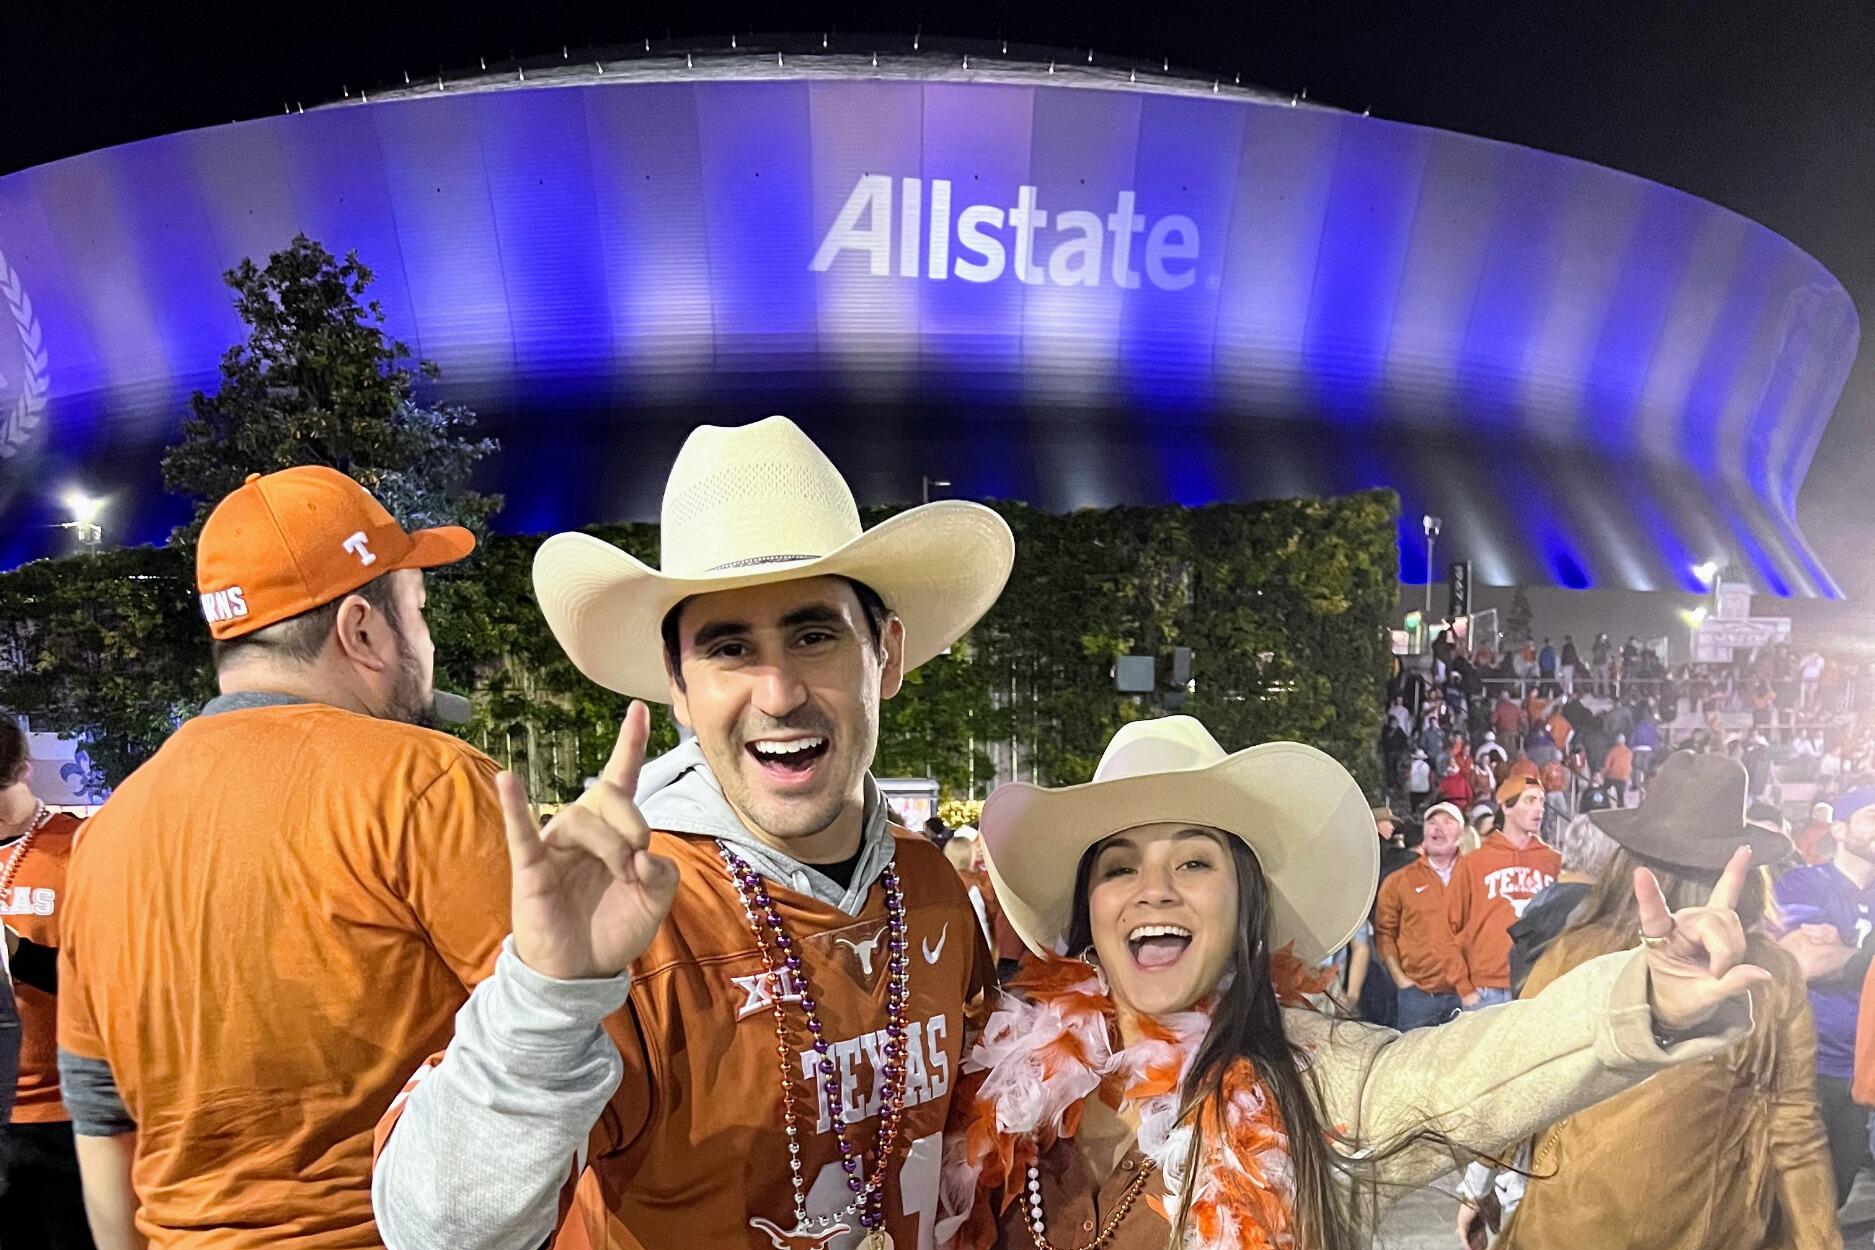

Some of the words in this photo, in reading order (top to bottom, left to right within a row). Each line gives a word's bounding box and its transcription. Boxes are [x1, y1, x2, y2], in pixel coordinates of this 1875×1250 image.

[808, 174, 1200, 291] Allstate
[342, 531, 377, 566] T
[0, 886, 56, 915] AS
[800, 1014, 949, 1135] TEXAS
